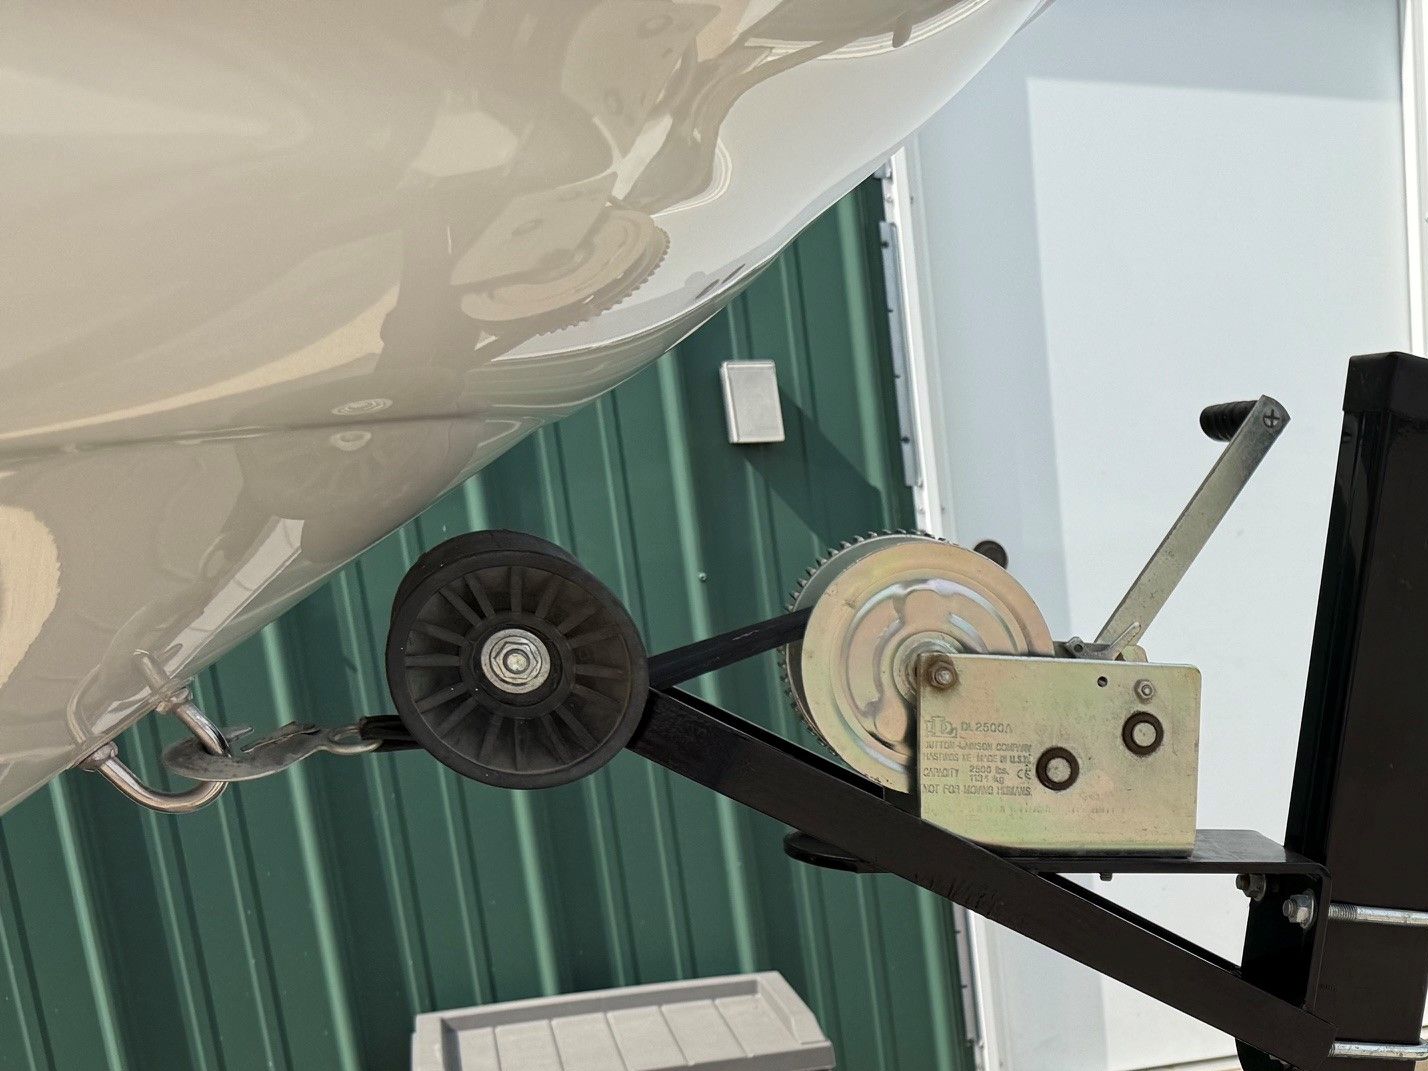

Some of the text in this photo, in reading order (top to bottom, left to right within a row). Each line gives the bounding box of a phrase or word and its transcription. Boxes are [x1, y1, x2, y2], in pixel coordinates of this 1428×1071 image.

[923, 767, 960, 778] CAPACITY
[923, 784, 939, 794] NOT
[943, 784, 960, 795] FOR
[964, 785, 994, 795] MOVING
